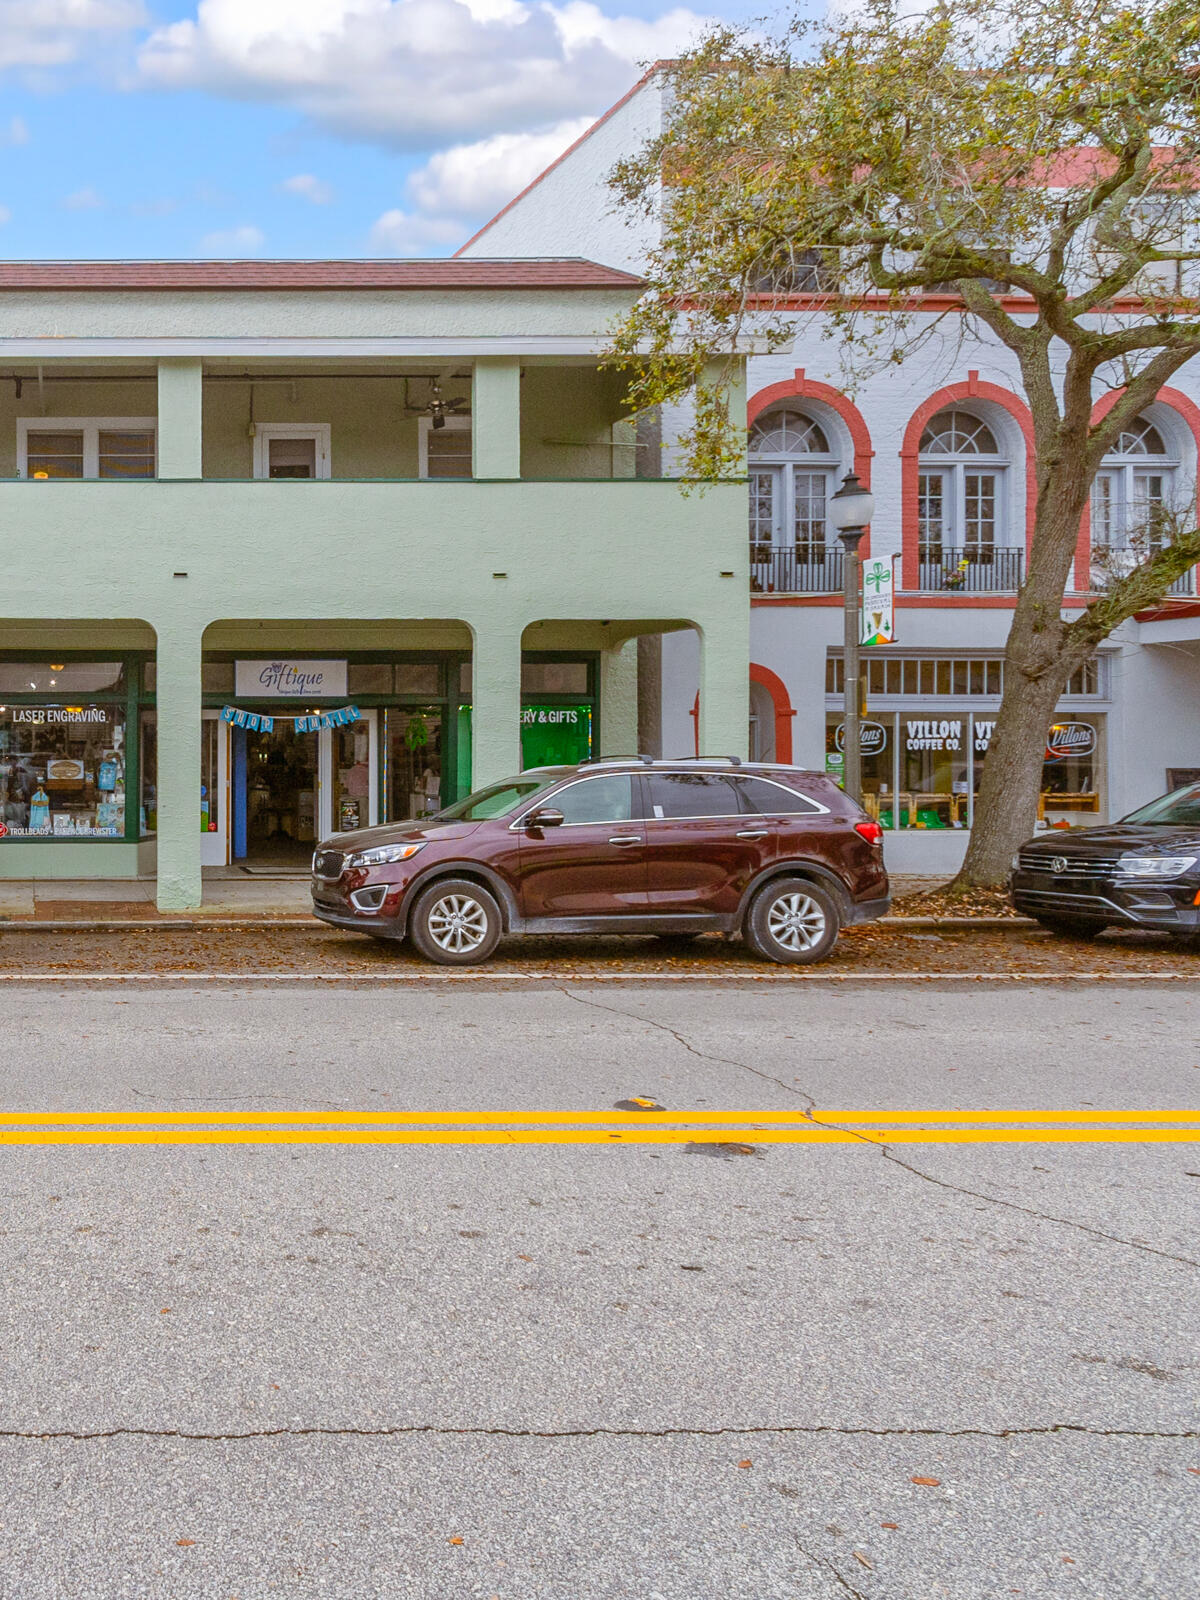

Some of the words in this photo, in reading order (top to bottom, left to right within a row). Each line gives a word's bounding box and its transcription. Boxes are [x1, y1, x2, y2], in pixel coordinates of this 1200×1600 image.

[259, 664, 323, 695] Giftique
[13, 710, 45, 723] LASER
[47, 710, 106, 723] ENGRAVING
[224, 707, 271, 729] SHOP
[298, 707, 357, 730] SMALL
[538, 710, 547, 723] &
[548, 710, 578, 723] GIFTS
[906, 720, 962, 739] VILLON
[974, 721, 997, 739] VI
[906, 738, 943, 751] COFFEE
[945, 738, 962, 751] CO.
[10, 827, 49, 836] TROLLBEADS
